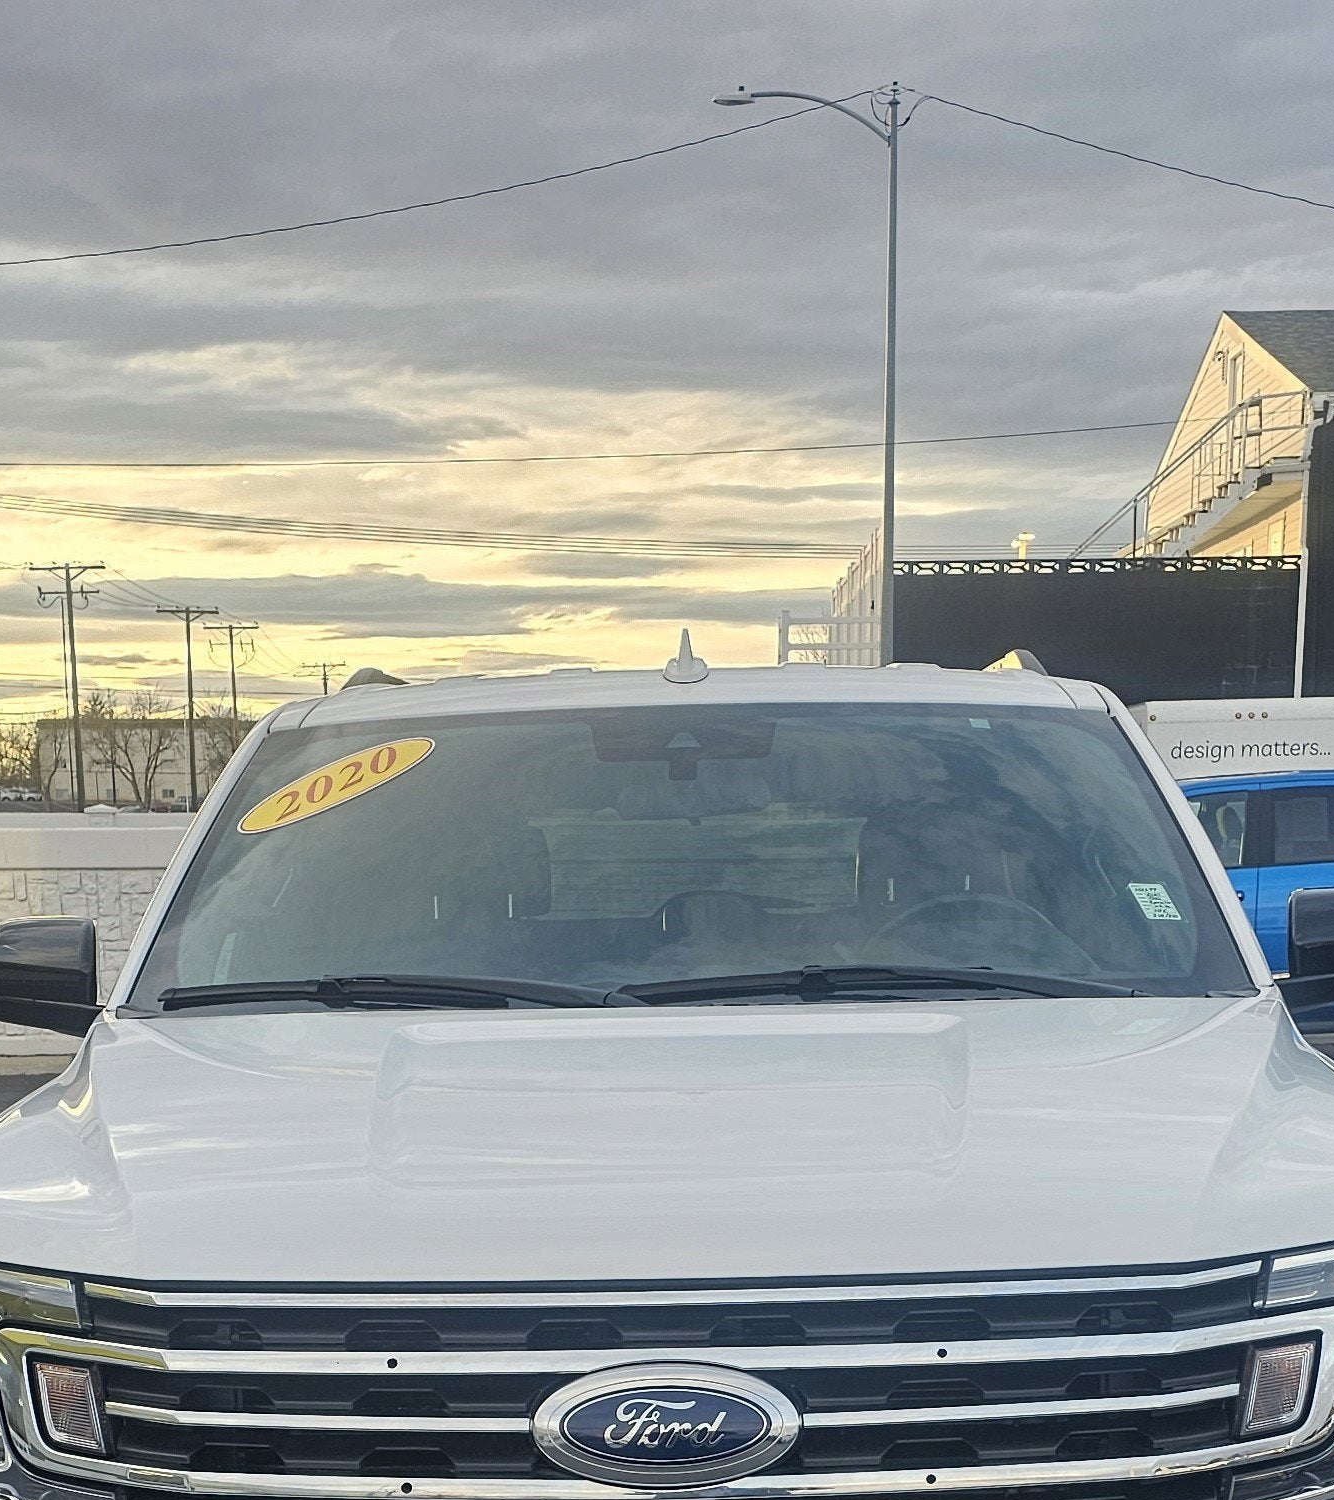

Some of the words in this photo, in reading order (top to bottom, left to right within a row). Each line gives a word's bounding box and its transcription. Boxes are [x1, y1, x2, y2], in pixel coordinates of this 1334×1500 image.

[1170, 741, 1234, 763] design
[1241, 740, 1331, 758] matters...
[275, 746, 397, 822] 2020
[603, 1398, 726, 1449] Ford
